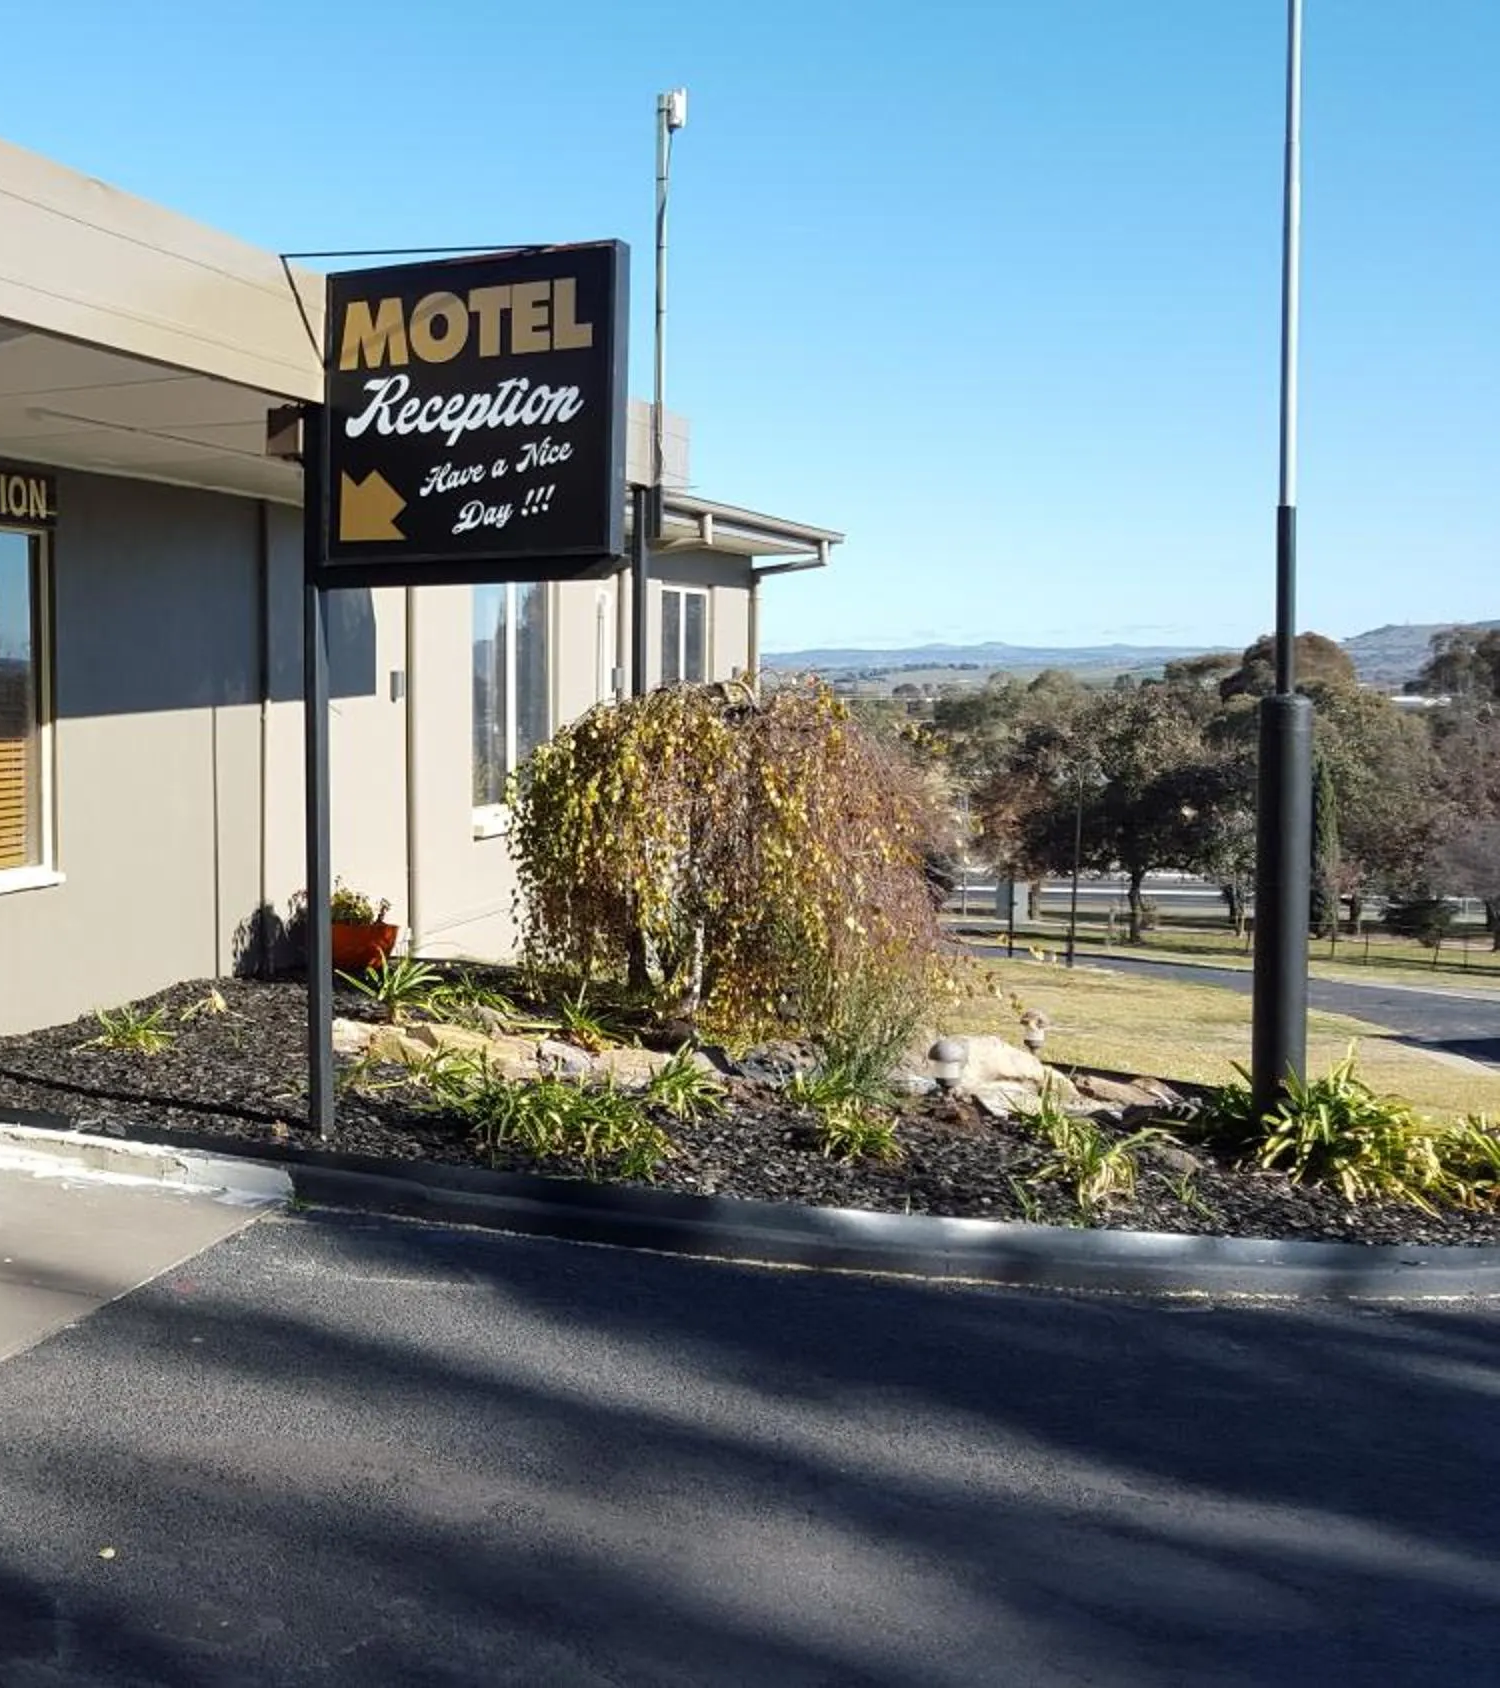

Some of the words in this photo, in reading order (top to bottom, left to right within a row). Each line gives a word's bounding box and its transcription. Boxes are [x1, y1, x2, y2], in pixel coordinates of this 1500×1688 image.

[339, 277, 593, 371] MOTEL
[345, 374, 585, 447] Reception
[419, 462, 487, 497] Have
[491, 458, 509, 479] a
[515, 436, 573, 474] Nice
[451, 499, 513, 536] Day
[521, 484, 556, 517] !!!
